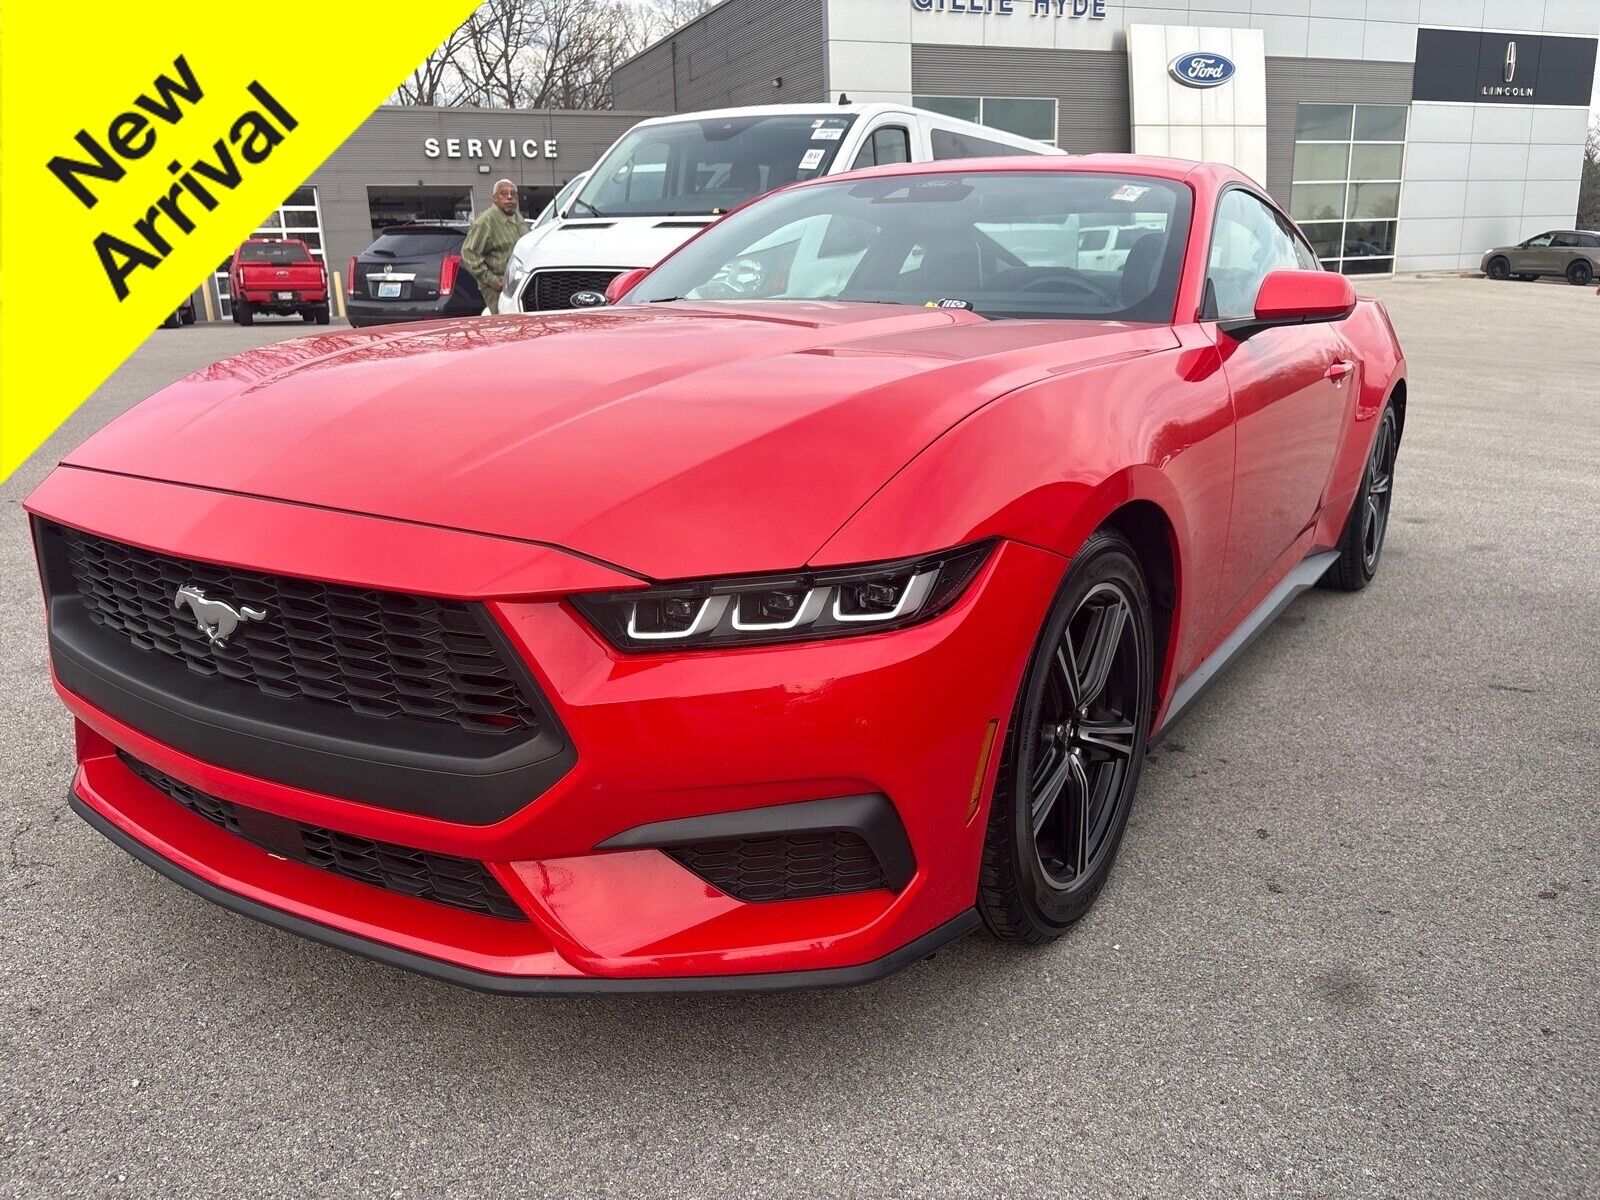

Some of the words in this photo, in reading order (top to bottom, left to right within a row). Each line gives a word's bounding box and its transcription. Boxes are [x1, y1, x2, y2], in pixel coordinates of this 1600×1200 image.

[1033, 0, 1106, 19] HYDE
[1187, 57, 1225, 79] Ford
[1482, 86, 1534, 96] LINCOLN
[424, 137, 558, 158] SERVICE
